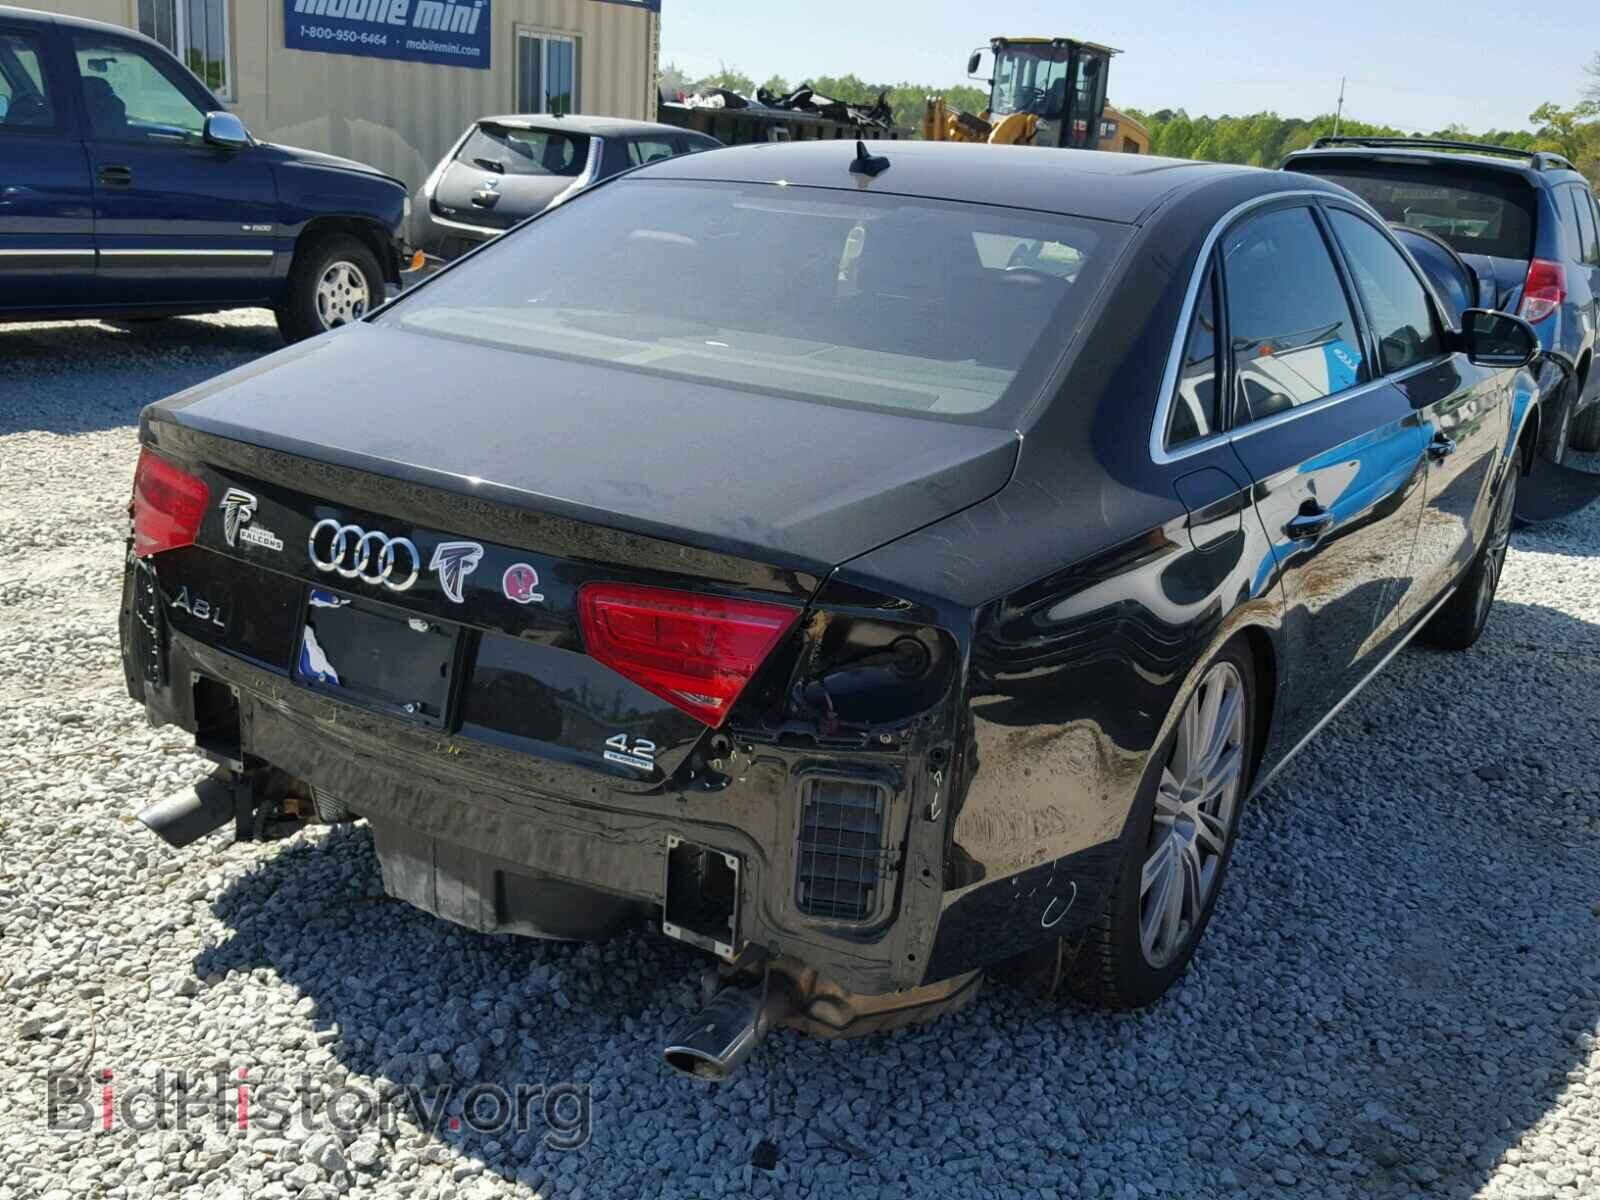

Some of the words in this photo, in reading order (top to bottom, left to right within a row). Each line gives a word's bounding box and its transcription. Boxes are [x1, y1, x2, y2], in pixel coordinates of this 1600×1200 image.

[412, 0, 482, 34] mini
[300, 25, 387, 45] 1-800-950-6464
[406, 39, 480, 56] mobilemini.com
[605, 733, 656, 759] 4.2
